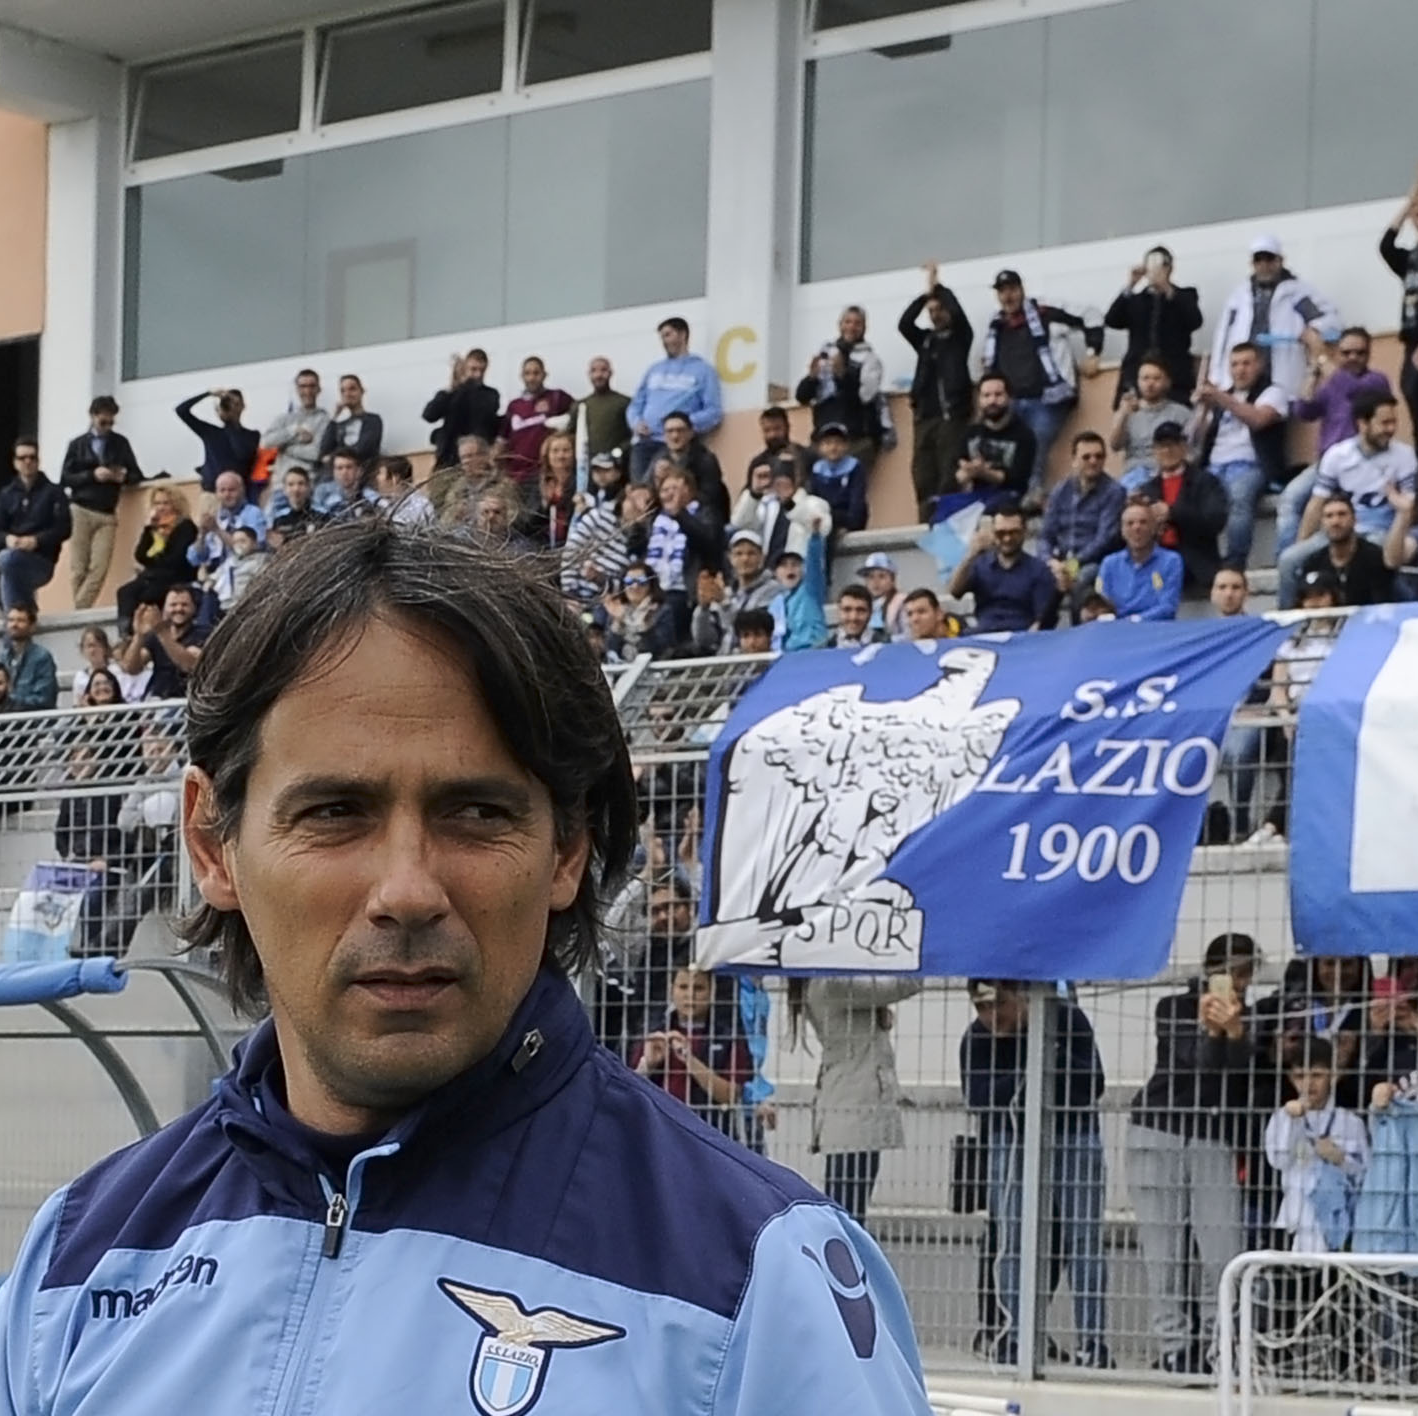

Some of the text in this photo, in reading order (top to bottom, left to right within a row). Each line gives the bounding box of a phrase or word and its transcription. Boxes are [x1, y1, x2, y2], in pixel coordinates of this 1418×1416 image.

[716, 326, 757, 384] C
[975, 735, 1220, 797] LAZIO
[1001, 821, 1161, 884] 1900
